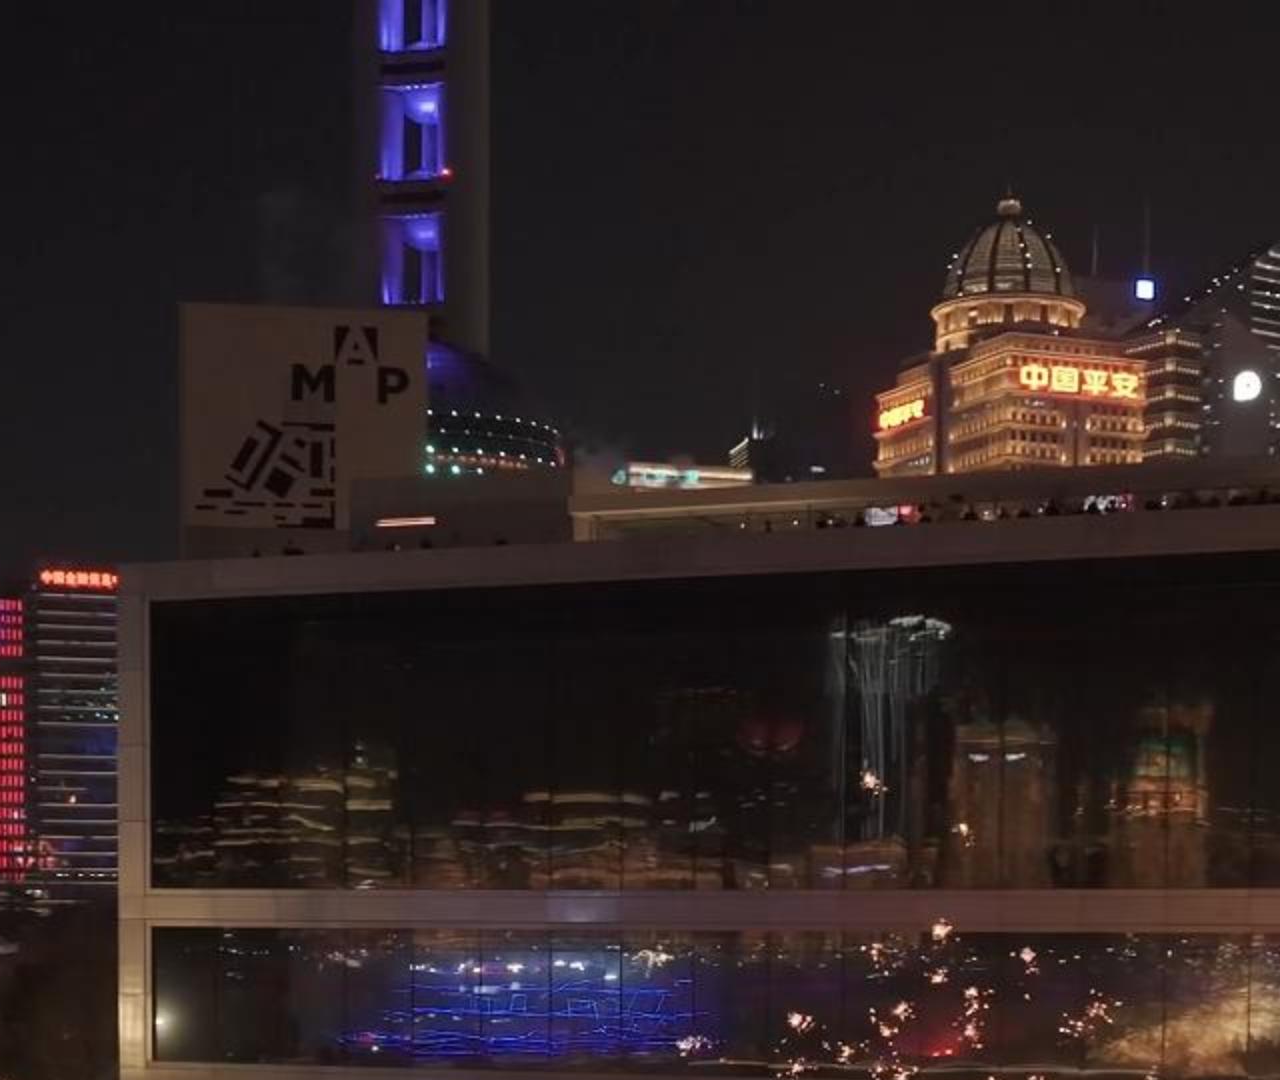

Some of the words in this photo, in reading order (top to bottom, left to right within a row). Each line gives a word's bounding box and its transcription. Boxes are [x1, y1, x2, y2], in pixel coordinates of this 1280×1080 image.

[290, 325, 410, 405] MAP
[1019, 363, 1139, 399] 中国平安
